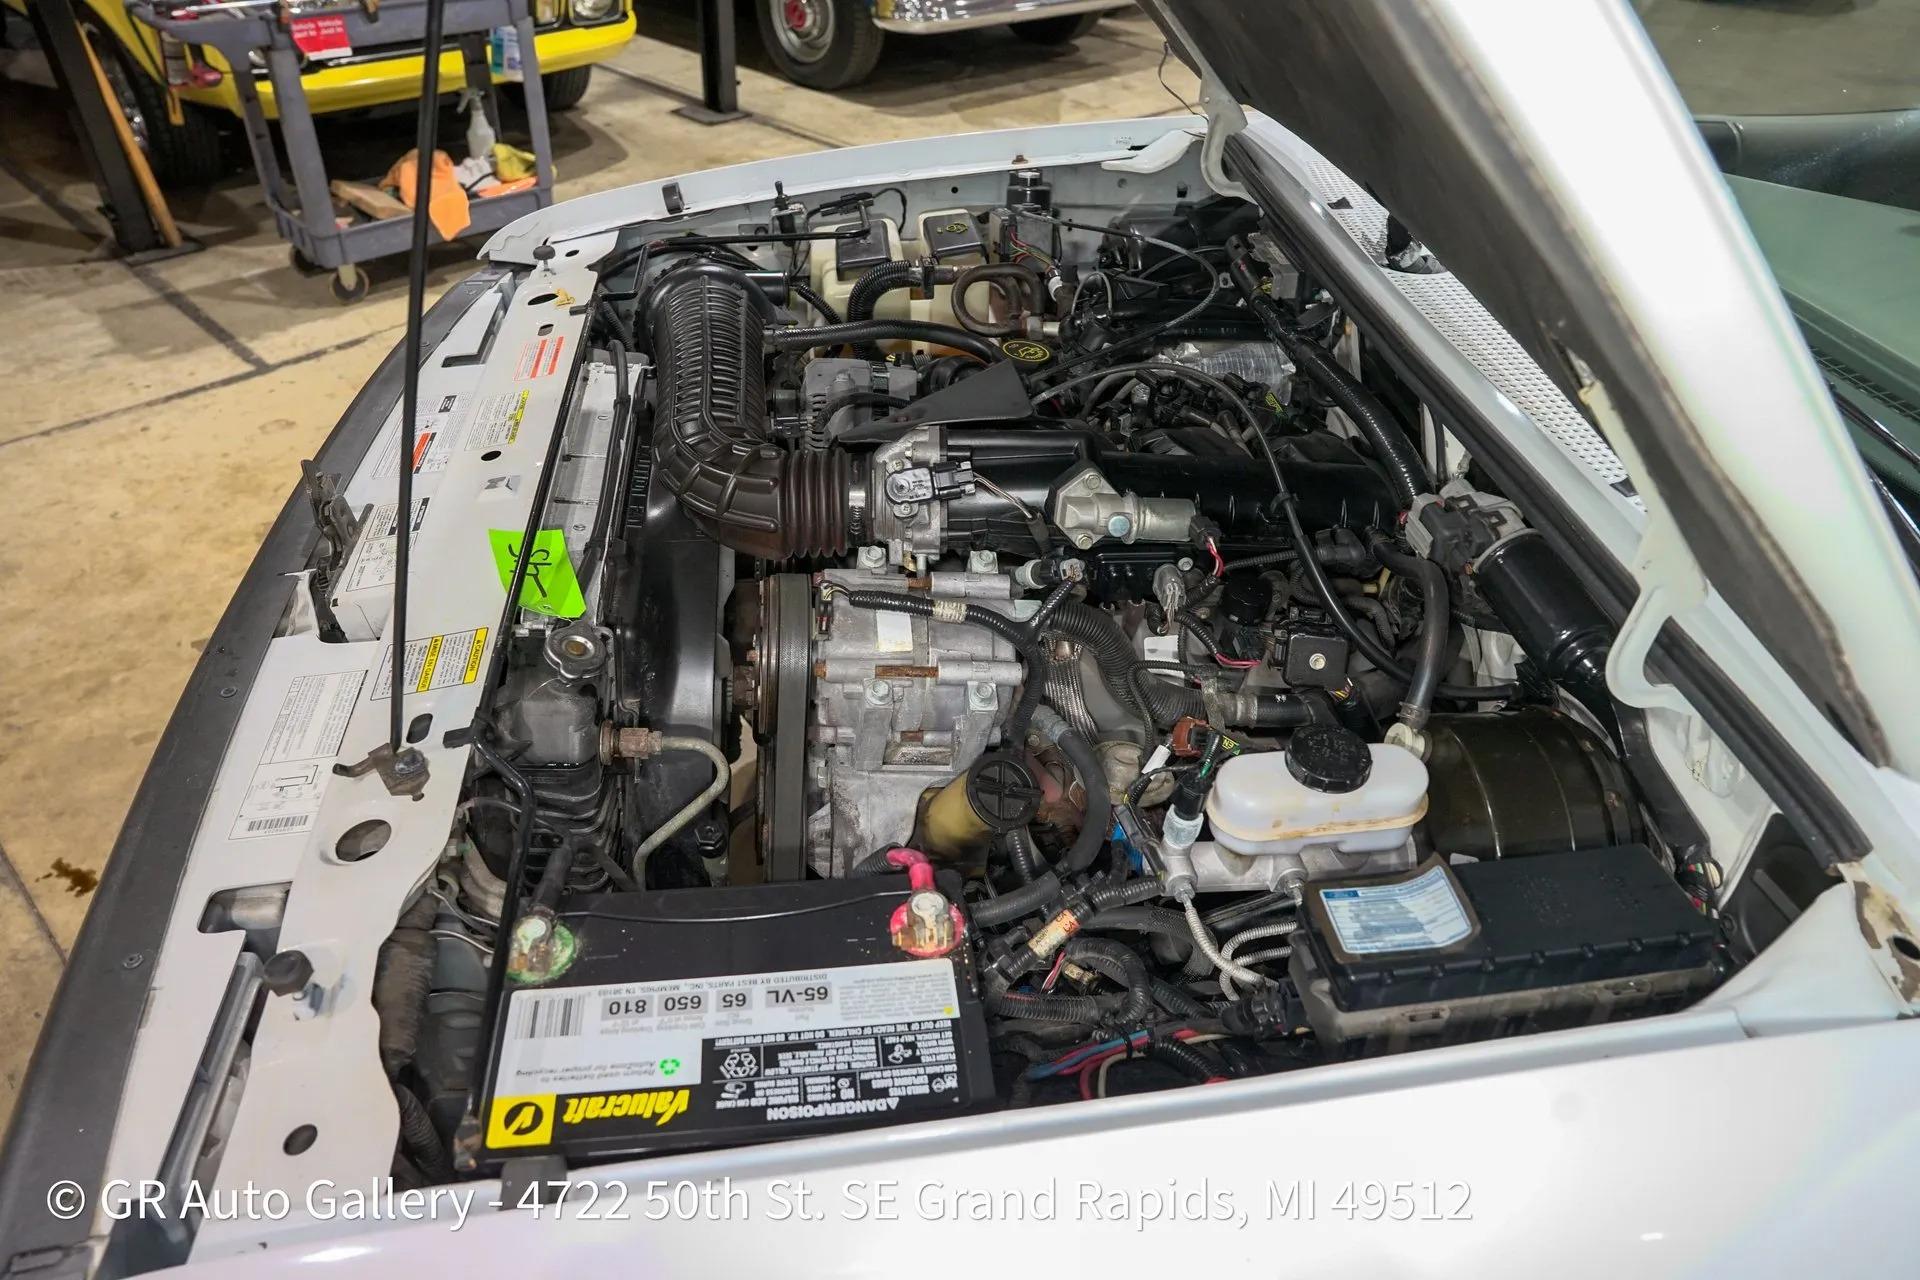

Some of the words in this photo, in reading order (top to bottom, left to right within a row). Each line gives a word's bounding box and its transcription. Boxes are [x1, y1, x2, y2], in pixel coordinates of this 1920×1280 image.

[469, 643, 481, 671] CAUTION
[663, 995, 701, 1011] 650
[722, 992, 746, 1008] 65
[767, 985, 828, 1004] 65-VL
[608, 999, 646, 1015] 810
[562, 1089, 690, 1126] Valucraft
[766, 1097, 887, 1120] DANGER/POISON
